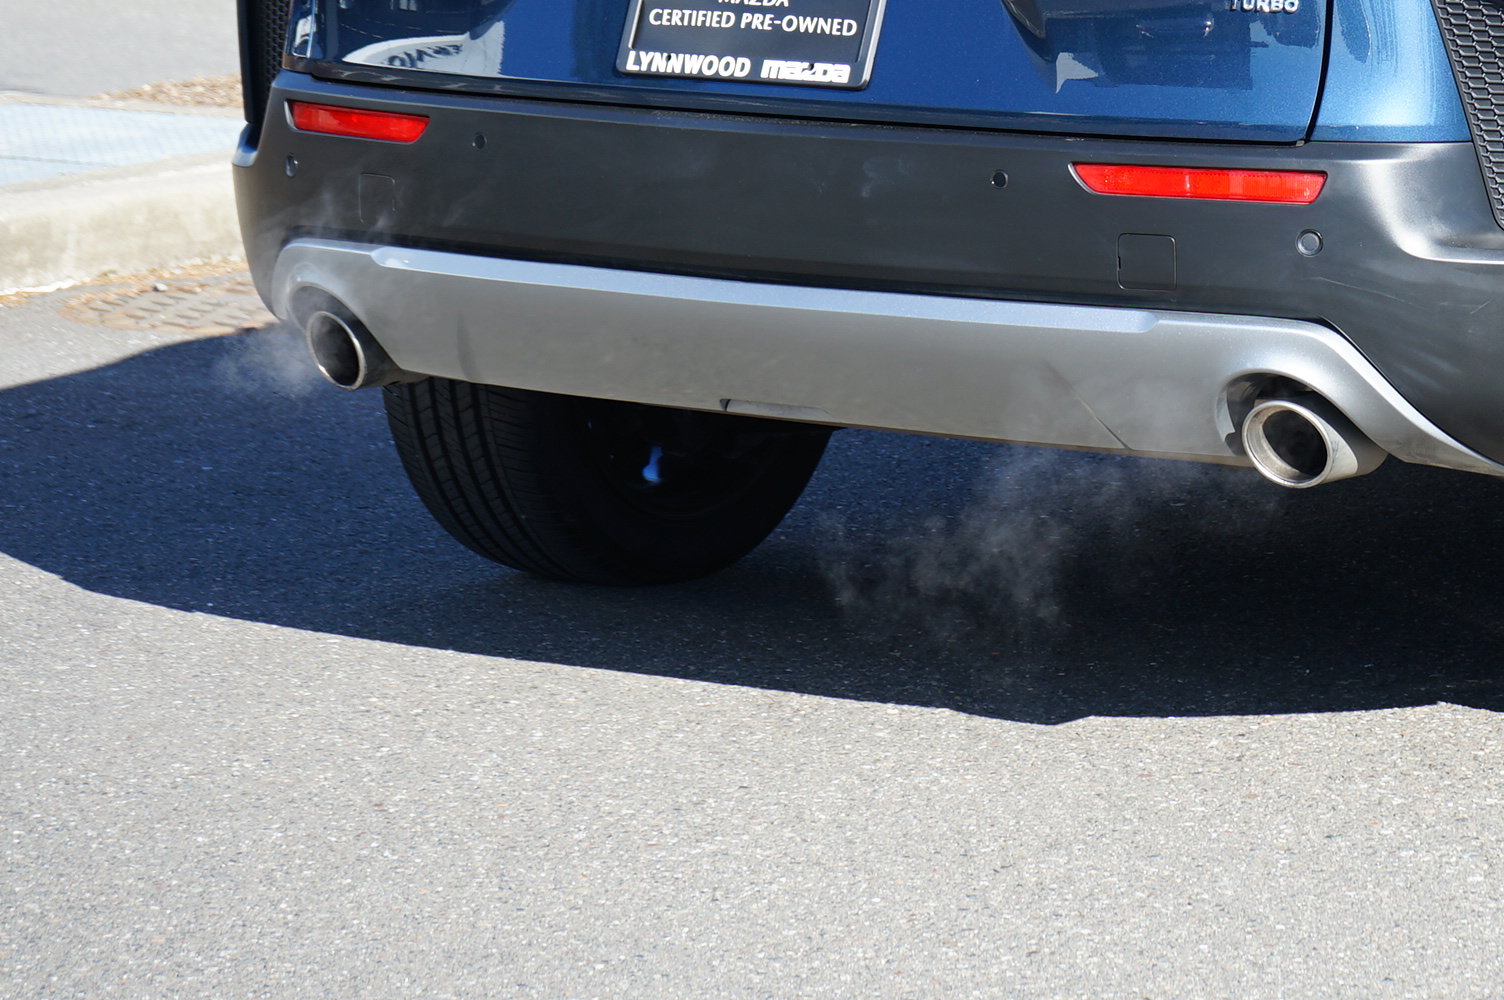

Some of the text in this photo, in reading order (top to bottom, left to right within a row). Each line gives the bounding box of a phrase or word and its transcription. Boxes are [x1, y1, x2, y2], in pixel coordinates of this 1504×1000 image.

[649, 8, 858, 36] CERTIFIED PRE-OWNED
[625, 50, 751, 77] LYNNWOOD
